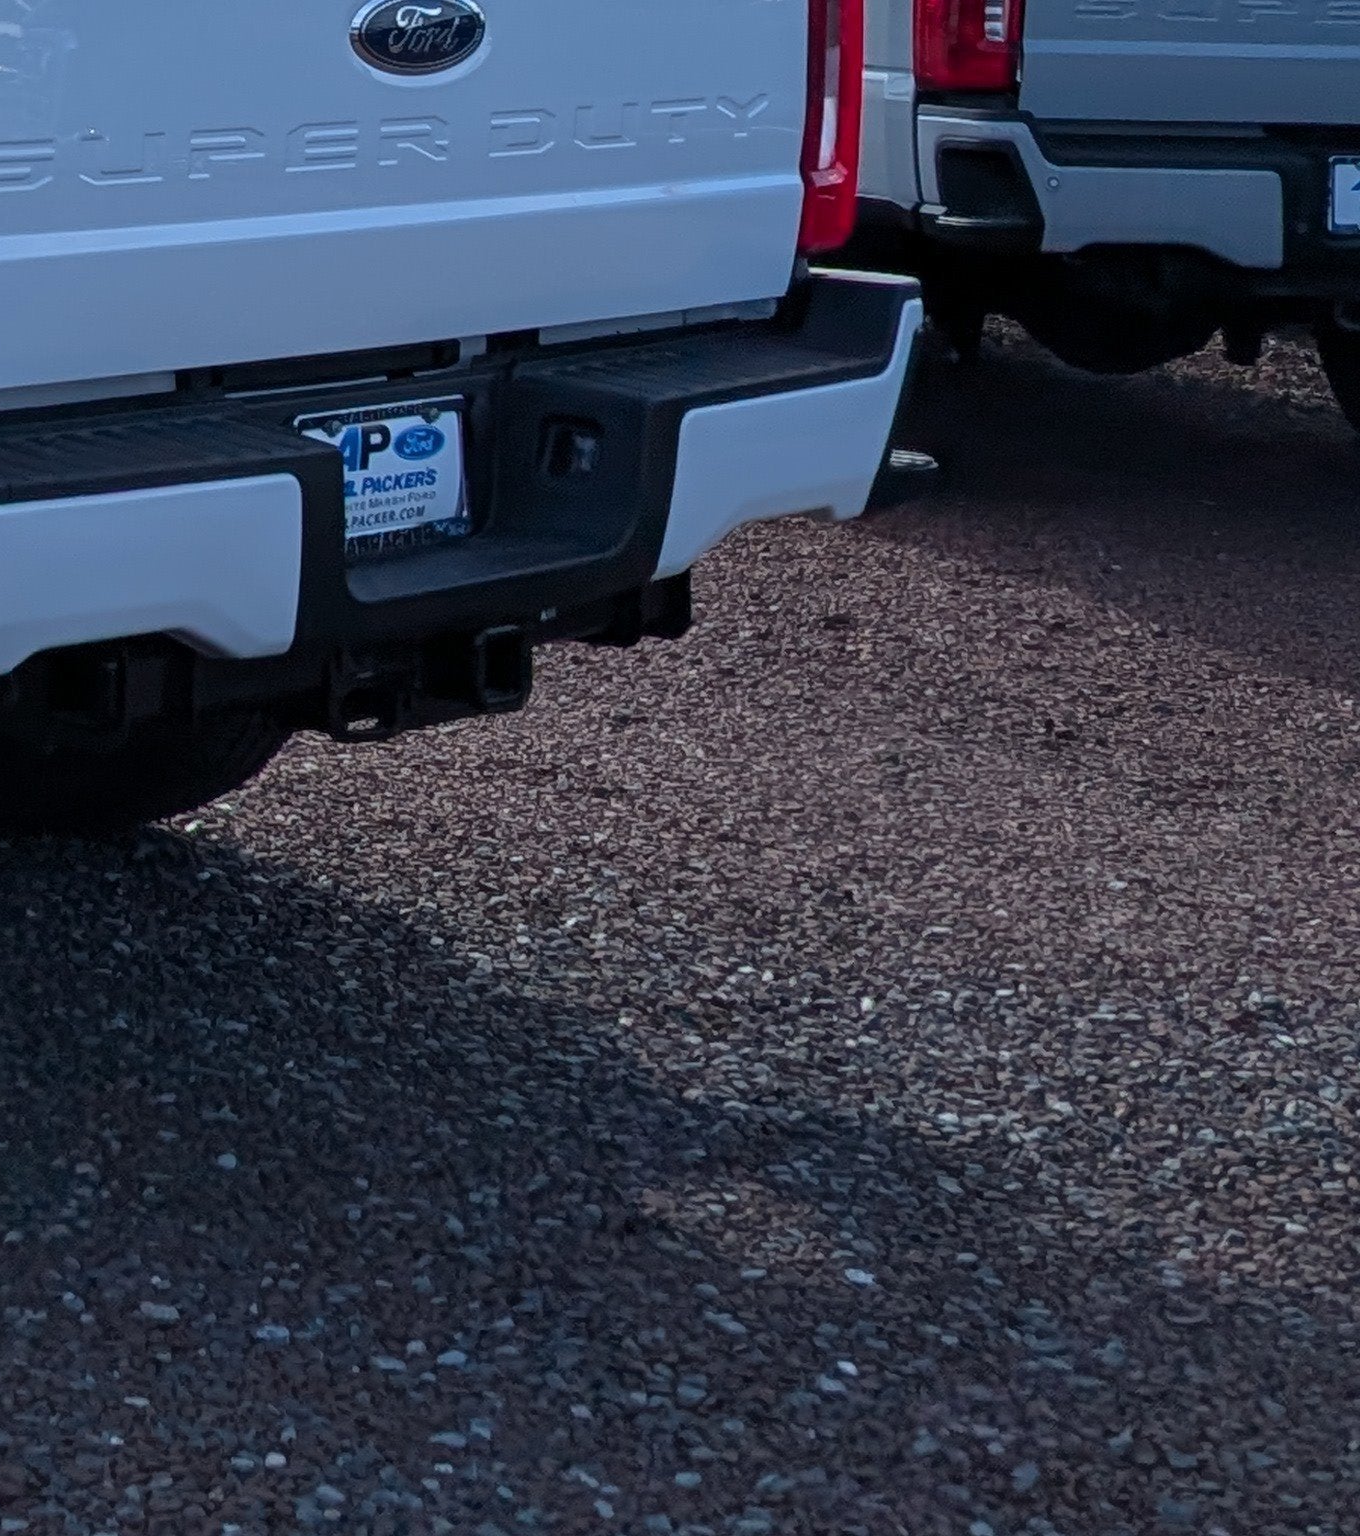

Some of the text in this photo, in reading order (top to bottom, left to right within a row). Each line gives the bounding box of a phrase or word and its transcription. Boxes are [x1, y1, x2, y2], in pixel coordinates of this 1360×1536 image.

[388, 5, 460, 54] Ford
[488, 92, 769, 158] DUTY
[348, 506, 425, 527] PACKER.COM
